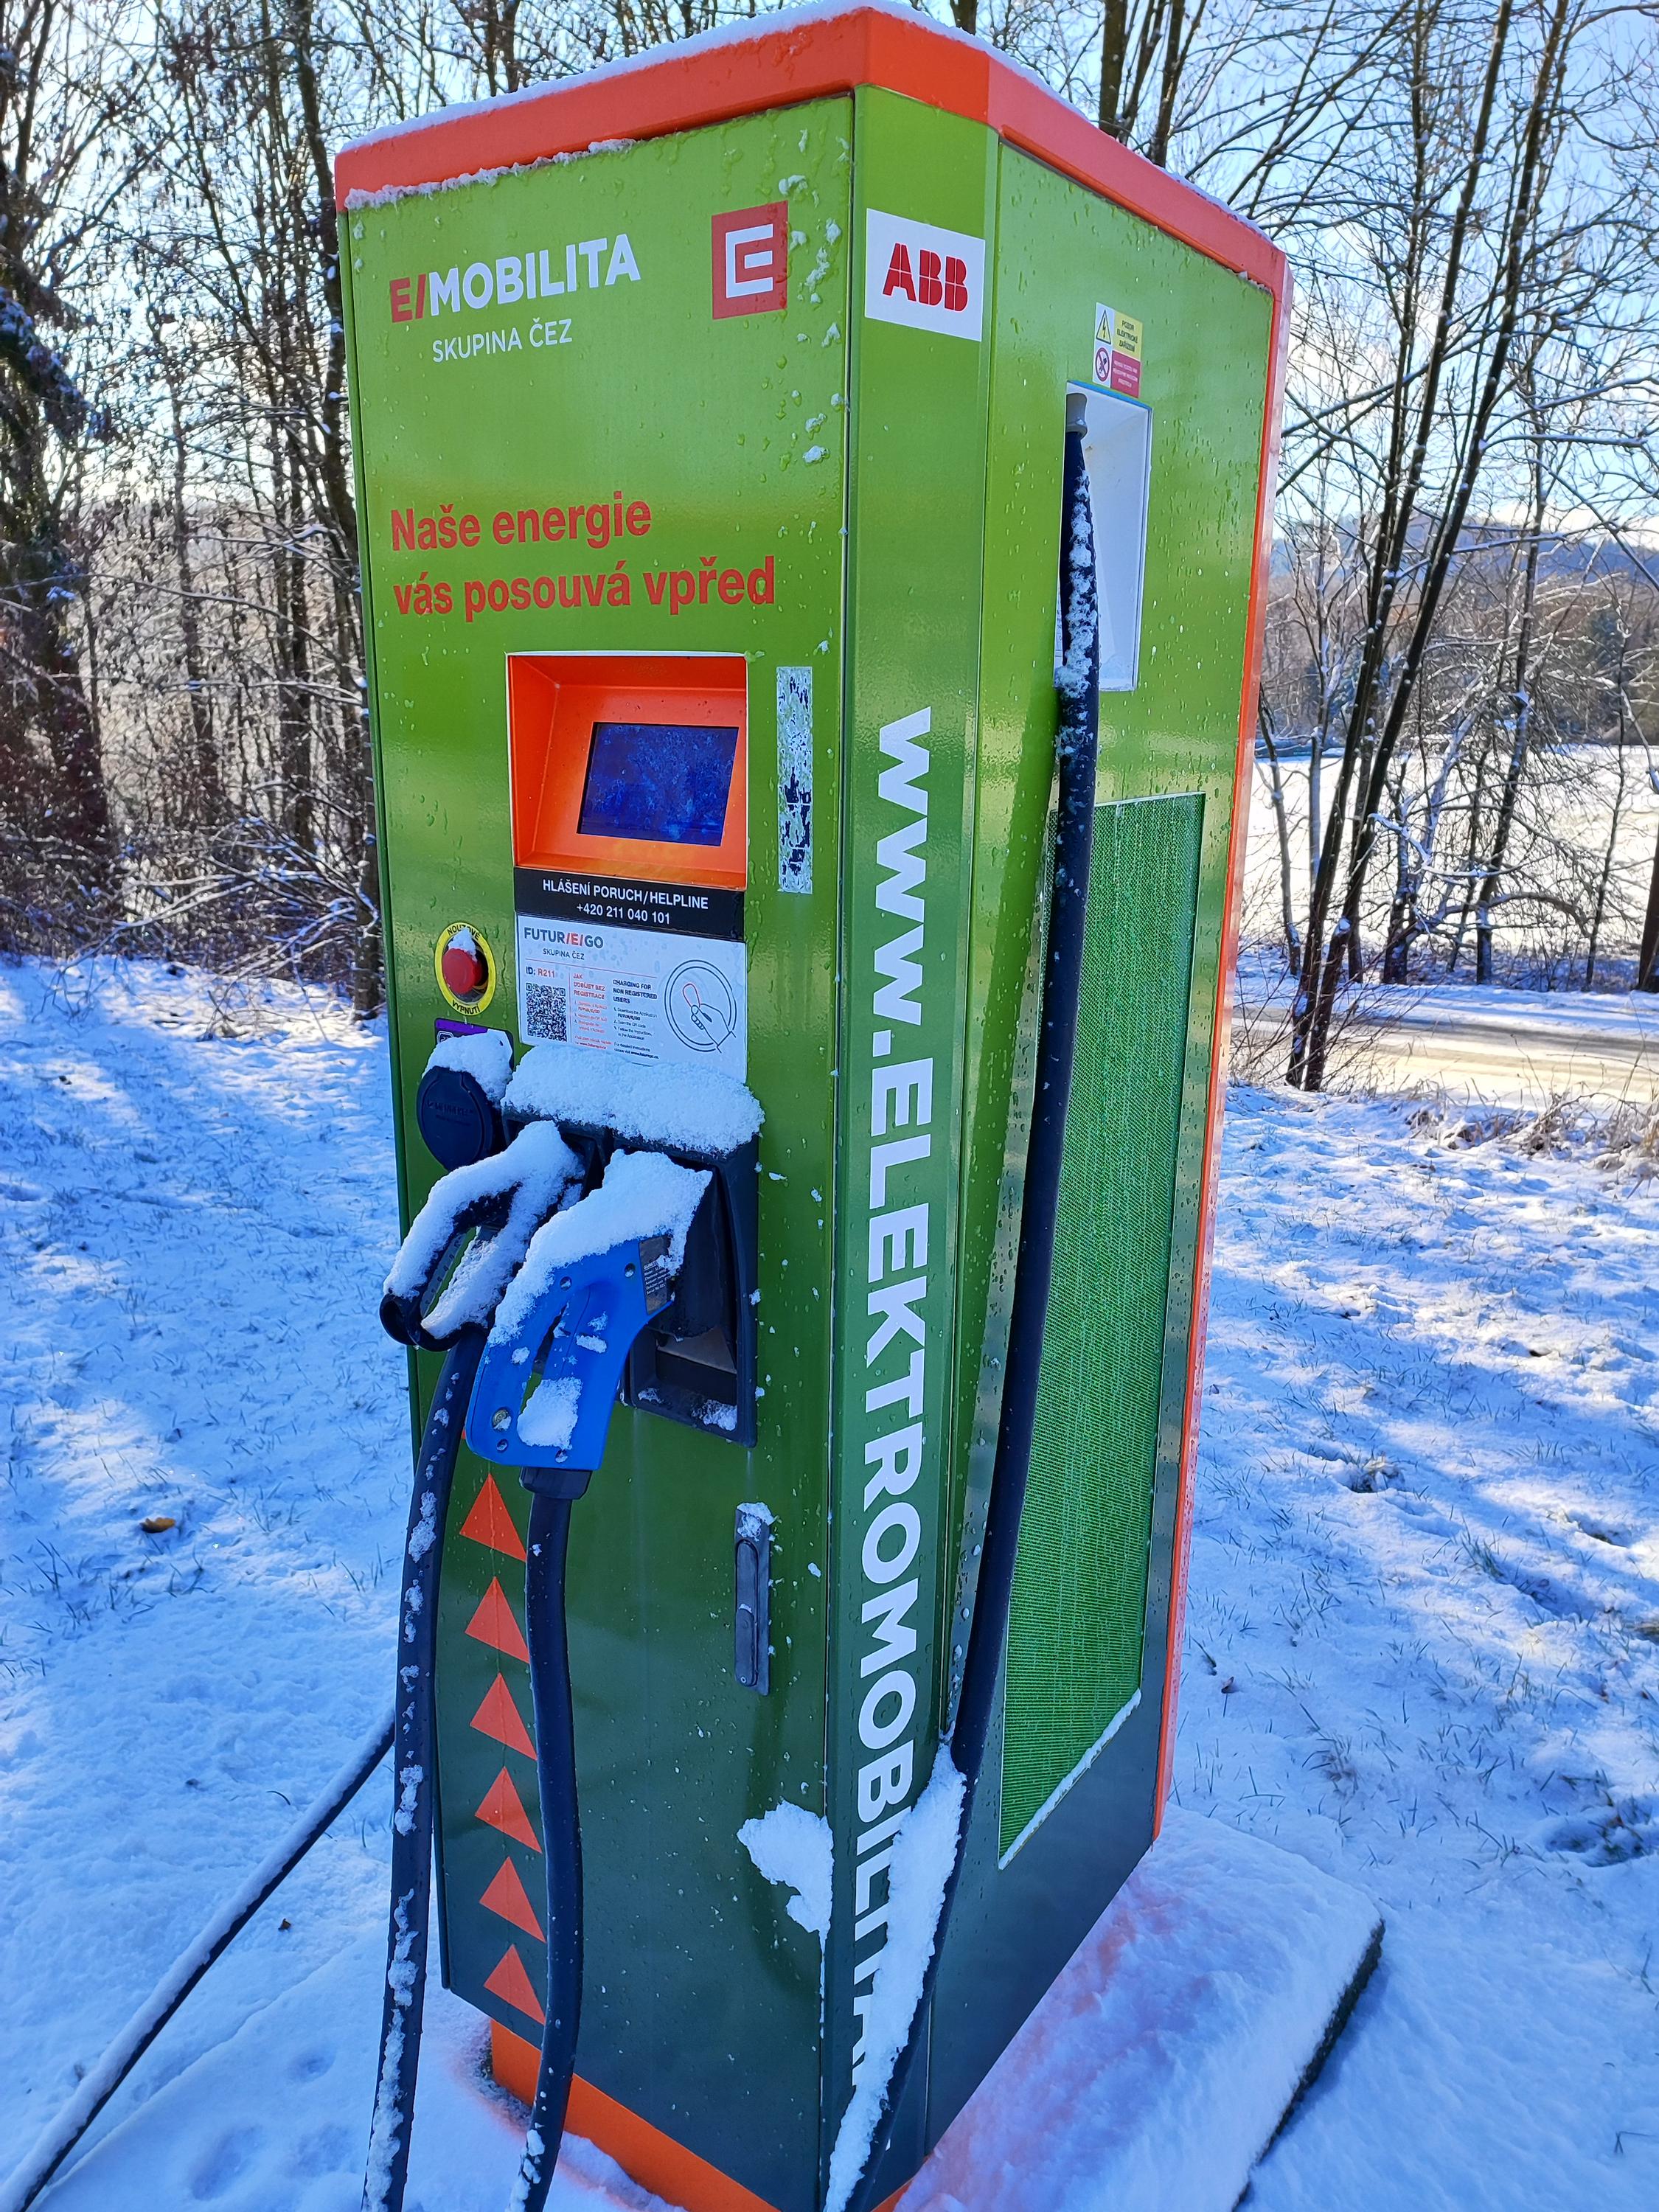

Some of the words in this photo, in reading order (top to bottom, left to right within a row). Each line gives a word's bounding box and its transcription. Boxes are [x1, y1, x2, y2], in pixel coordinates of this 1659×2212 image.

[389, 233, 641, 323] E/MOBILITA
[882, 242, 969, 313] ABB
[431, 327, 522, 362] SKUPINA
[529, 317, 573, 348] ČEZ
[390, 504, 481, 552] Naše
[492, 490, 652, 549] energie
[393, 571, 453, 615] vás
[464, 560, 631, 623] posouvá
[643, 555, 775, 616] vpřed
[543, 878, 591, 896] HLÁŠENÍ
[594, 885, 709, 910] PORUCH/HELPLINE
[577, 902, 603, 916] +420
[606, 905, 624, 919] 211
[627, 908, 648, 922] 040
[652, 911, 670, 925] 101
[524, 927, 604, 949] FUTUR/E/GO
[543, 948, 570, 959] SKUPINA
[571, 951, 585, 960] ČEZ
[526, 966, 535, 975] ID:
[538, 967, 555, 978] R211
[452, 1000, 480, 1015] VYPNUTÍ
